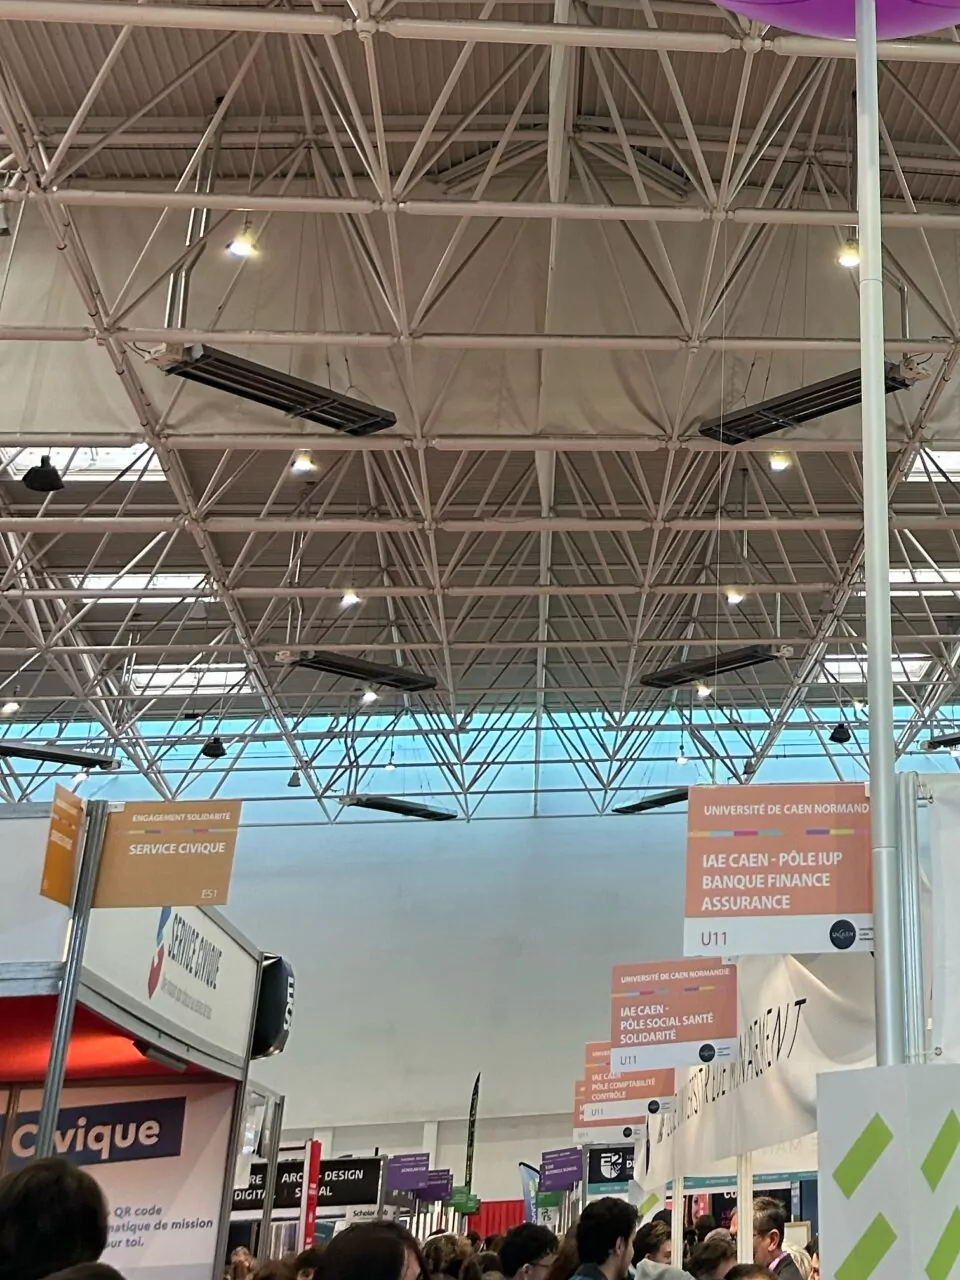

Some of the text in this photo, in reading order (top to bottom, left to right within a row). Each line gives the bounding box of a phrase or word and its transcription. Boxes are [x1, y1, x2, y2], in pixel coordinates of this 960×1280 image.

[132, 811, 231, 822] ENGAGEMENT SOLIDARITÉ
[704, 803, 869, 816] UNIVERSITÉ DE CAEN NORMAND
[129, 842, 226, 855] SERVICE CIVIQUE
[703, 854, 726, 868] IAE
[729, 852, 769, 867] CAEN
[779, 850, 816, 866] PÔLE
[818, 852, 843, 865] IUP
[702, 873, 831, 890] BANQUE FINANCE
[702, 895, 790, 911] ASSURANCE
[701, 932, 727, 946] U11
[168, 912, 222, 990] SERVICE CIVIQUE
[620, 972, 659, 983] UNIVERSITÉ
[670, 971, 688, 980] CAEN
[689, 968, 730, 979] NORMANDIE
[620, 1006, 637, 1017] IAE
[637, 1004, 664, 1016] CAEN
[620, 1012, 714, 1030] PÔLE SOCIAL SANTÉ
[620, 1029, 677, 1044] SOLIDARITÉ
[620, 1055, 637, 1065] U11
[592, 1077, 656, 1091] PÔLE COMPTABILITÉ
[592, 1091, 626, 1101] CONTRÔLE
[12, 1117, 160, 1159] Cvique
[324, 1170, 364, 1181] DESIGN
[114, 1204, 162, 1217] QR code
[153, 1220, 167, 1231] de
[171, 1219, 213, 1230] mission
